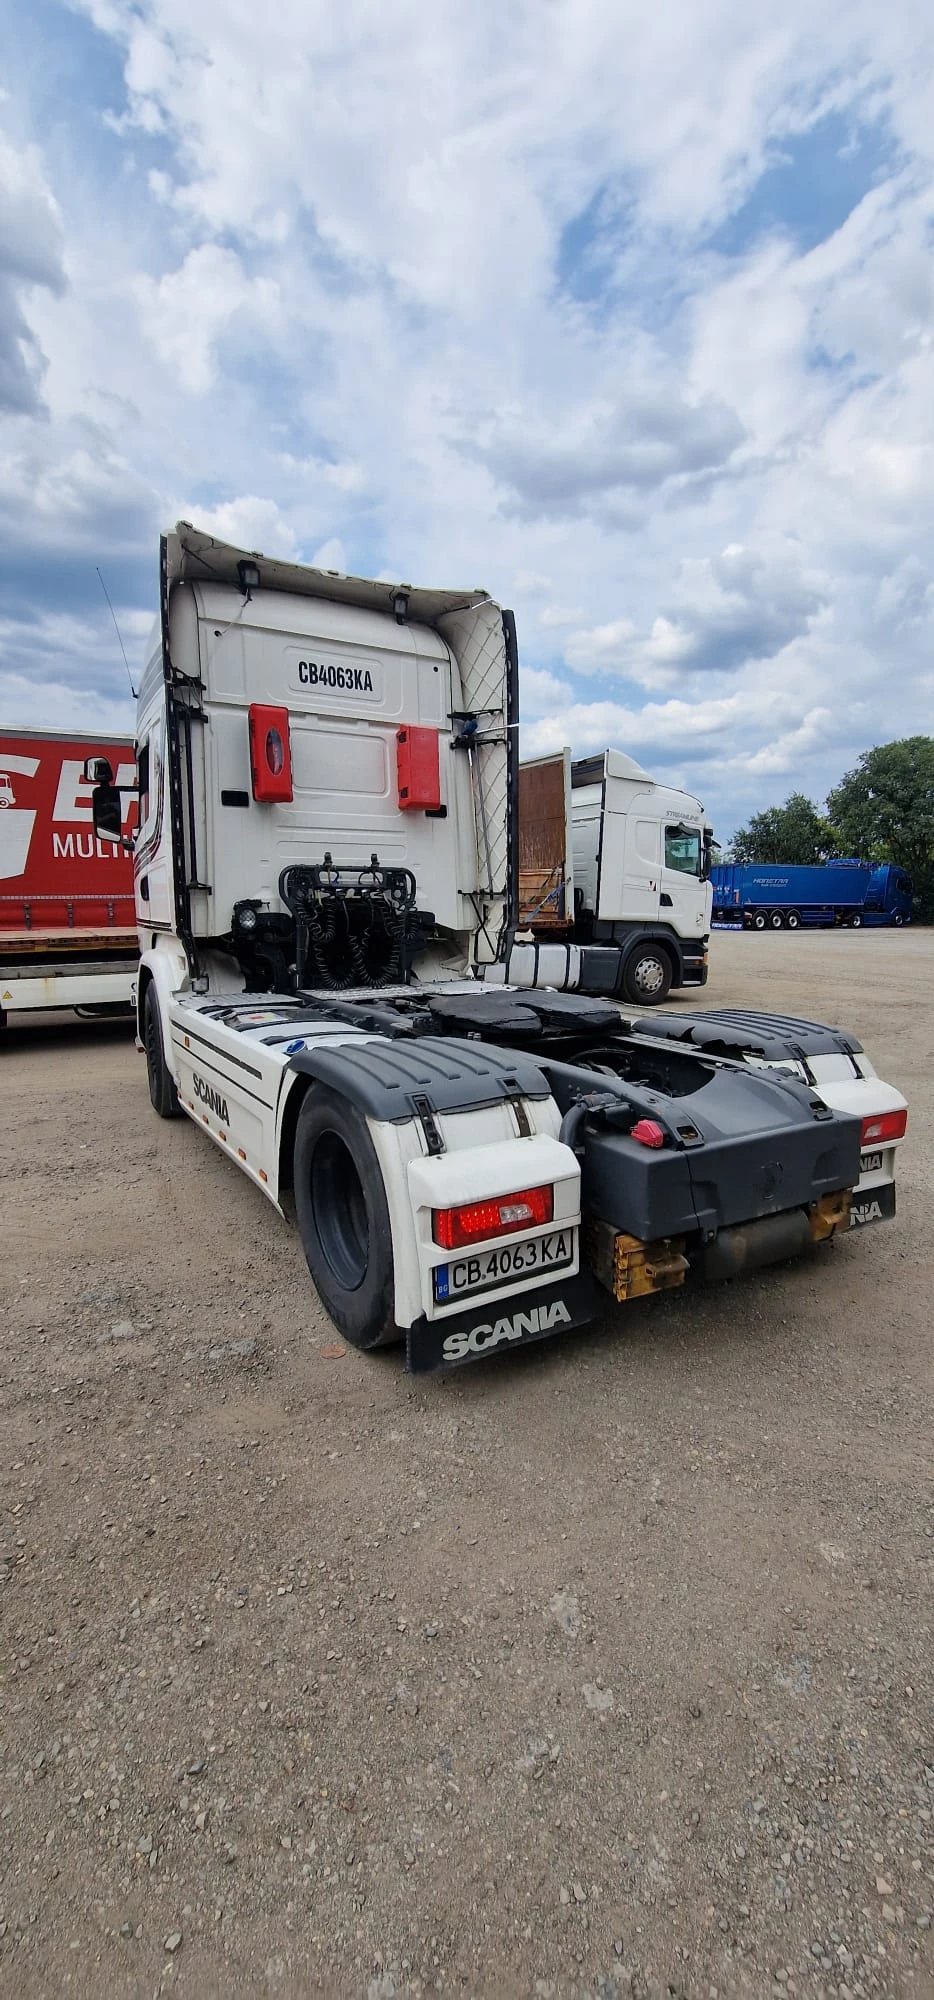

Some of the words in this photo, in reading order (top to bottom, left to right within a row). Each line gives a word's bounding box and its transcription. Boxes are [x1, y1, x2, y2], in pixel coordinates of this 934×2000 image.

[298, 661, 373, 692] CB4063KA
[193, 1072, 230, 1127] SCANIA
[438, 1284, 448, 1293] BG
[442, 1300, 572, 1361] SCANIA
